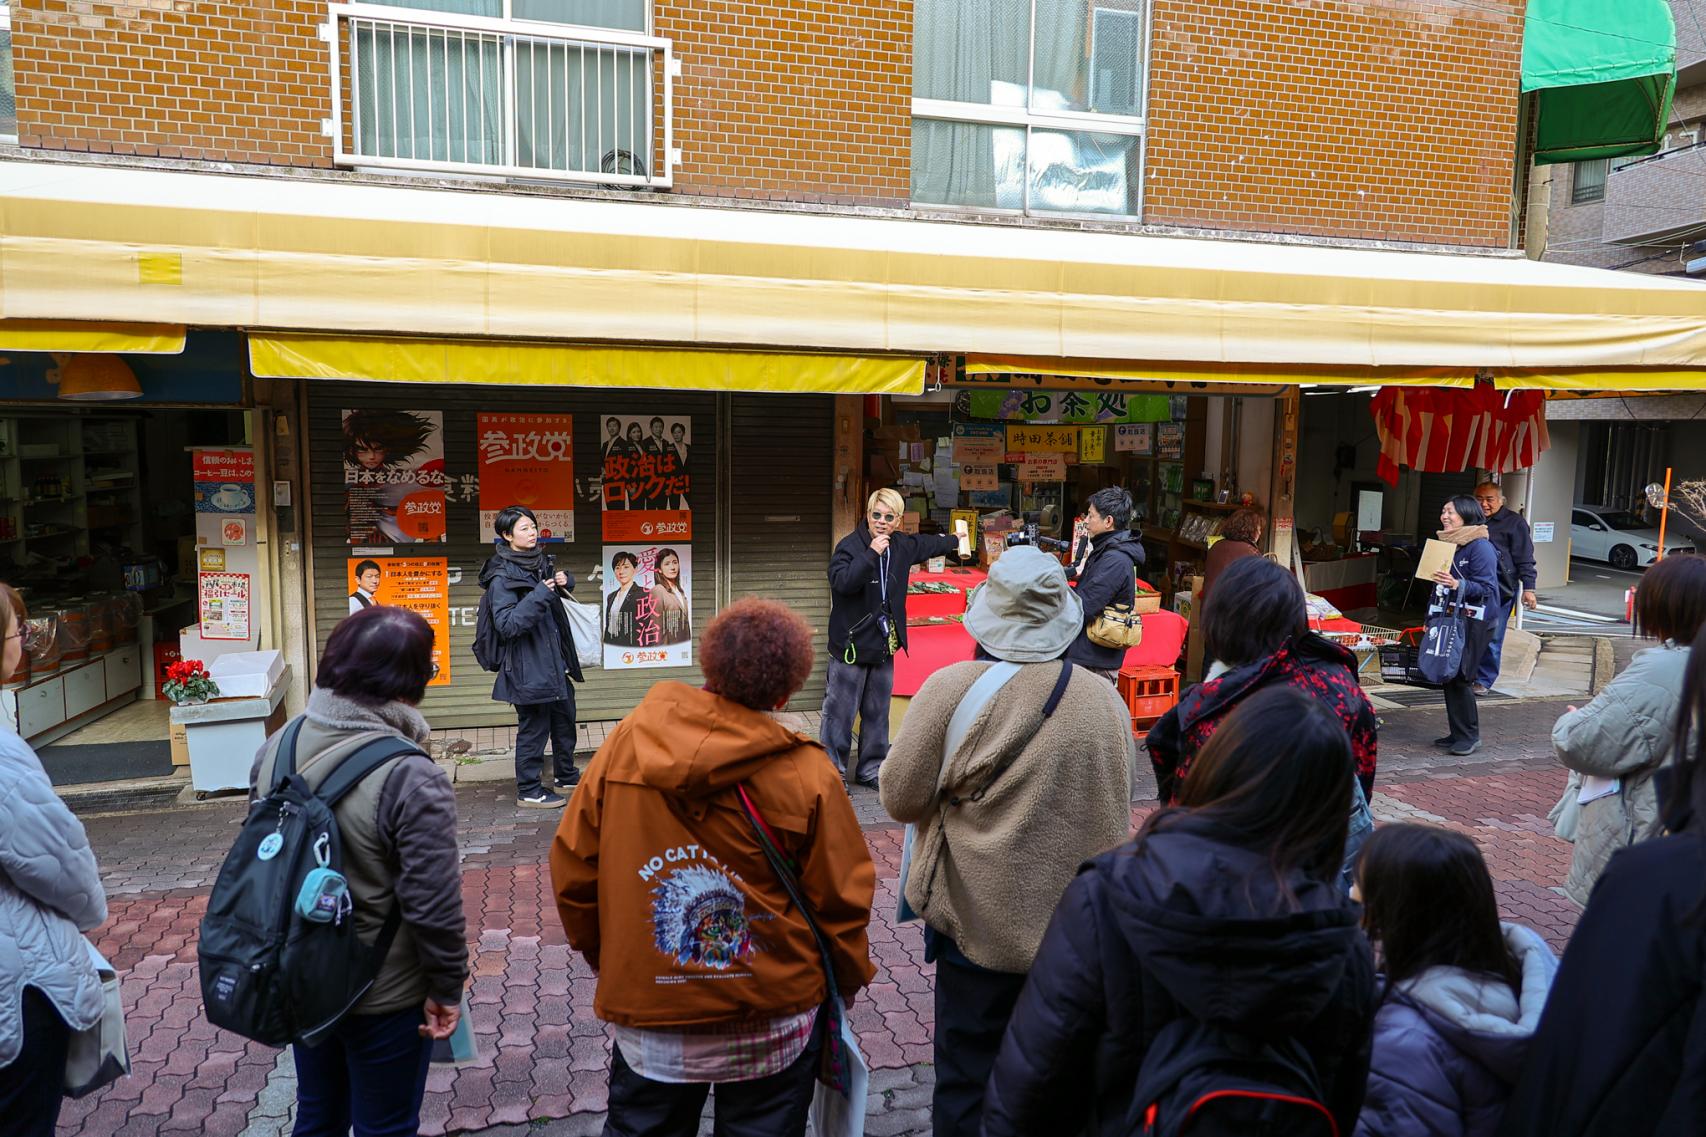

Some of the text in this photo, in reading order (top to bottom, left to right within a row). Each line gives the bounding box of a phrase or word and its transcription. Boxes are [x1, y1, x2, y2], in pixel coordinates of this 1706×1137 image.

[1020, 390, 1128, 418] お茶処
[480, 430, 571, 464] 参政党
[1013, 431, 1073, 446] 時田茶舗
[604, 452, 675, 481] 政治は
[404, 501, 442, 514] 参政党
[656, 522, 687, 534] 参政党
[635, 546, 661, 647] 愛と政治
[448, 607, 479, 626] TE
[637, 651, 668, 663] 参政党
[638, 844, 699, 882] NO CAT
